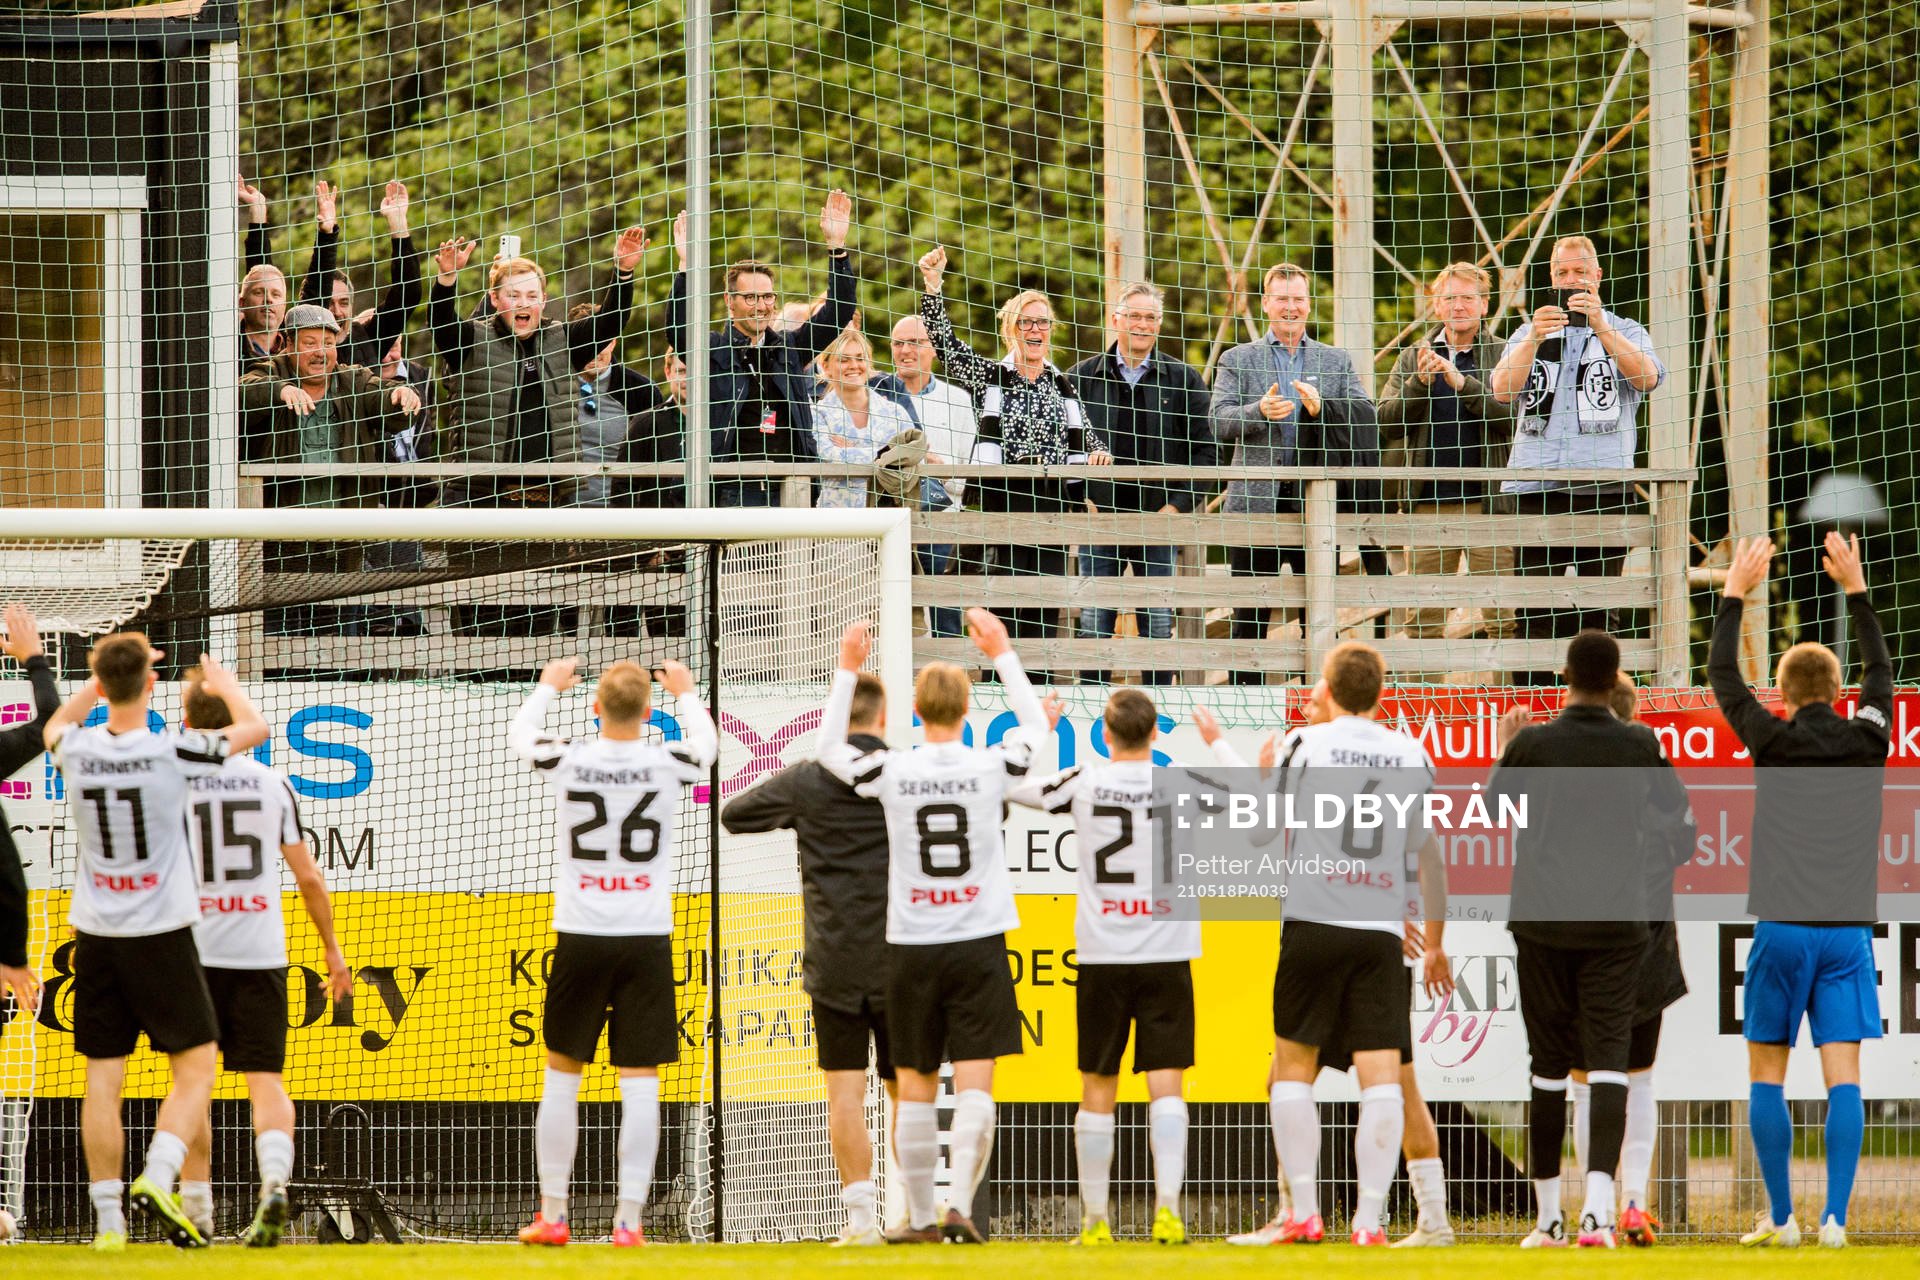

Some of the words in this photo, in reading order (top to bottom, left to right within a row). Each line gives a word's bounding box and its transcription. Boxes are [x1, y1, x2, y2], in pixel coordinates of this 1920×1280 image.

[79, 758, 155, 777] SERNEKE
[1331, 749, 1404, 771] SERNEKE
[574, 766, 654, 786] SERNEKE
[898, 776, 981, 797] SERNEKE
[1094, 786, 1166, 804] SERNEKE
[83, 786, 148, 862] 11
[566, 790, 662, 863] 26
[1341, 779, 1384, 860] 6
[194, 799, 263, 884] 15
[915, 803, 972, 878] 8
[1092, 803, 1173, 884] 21
[93, 872, 158, 892] PULS
[580, 874, 651, 892] PULS
[201, 895, 268, 913] PULS
[911, 885, 980, 906] PULS
[1102, 898, 1172, 917] PULS
